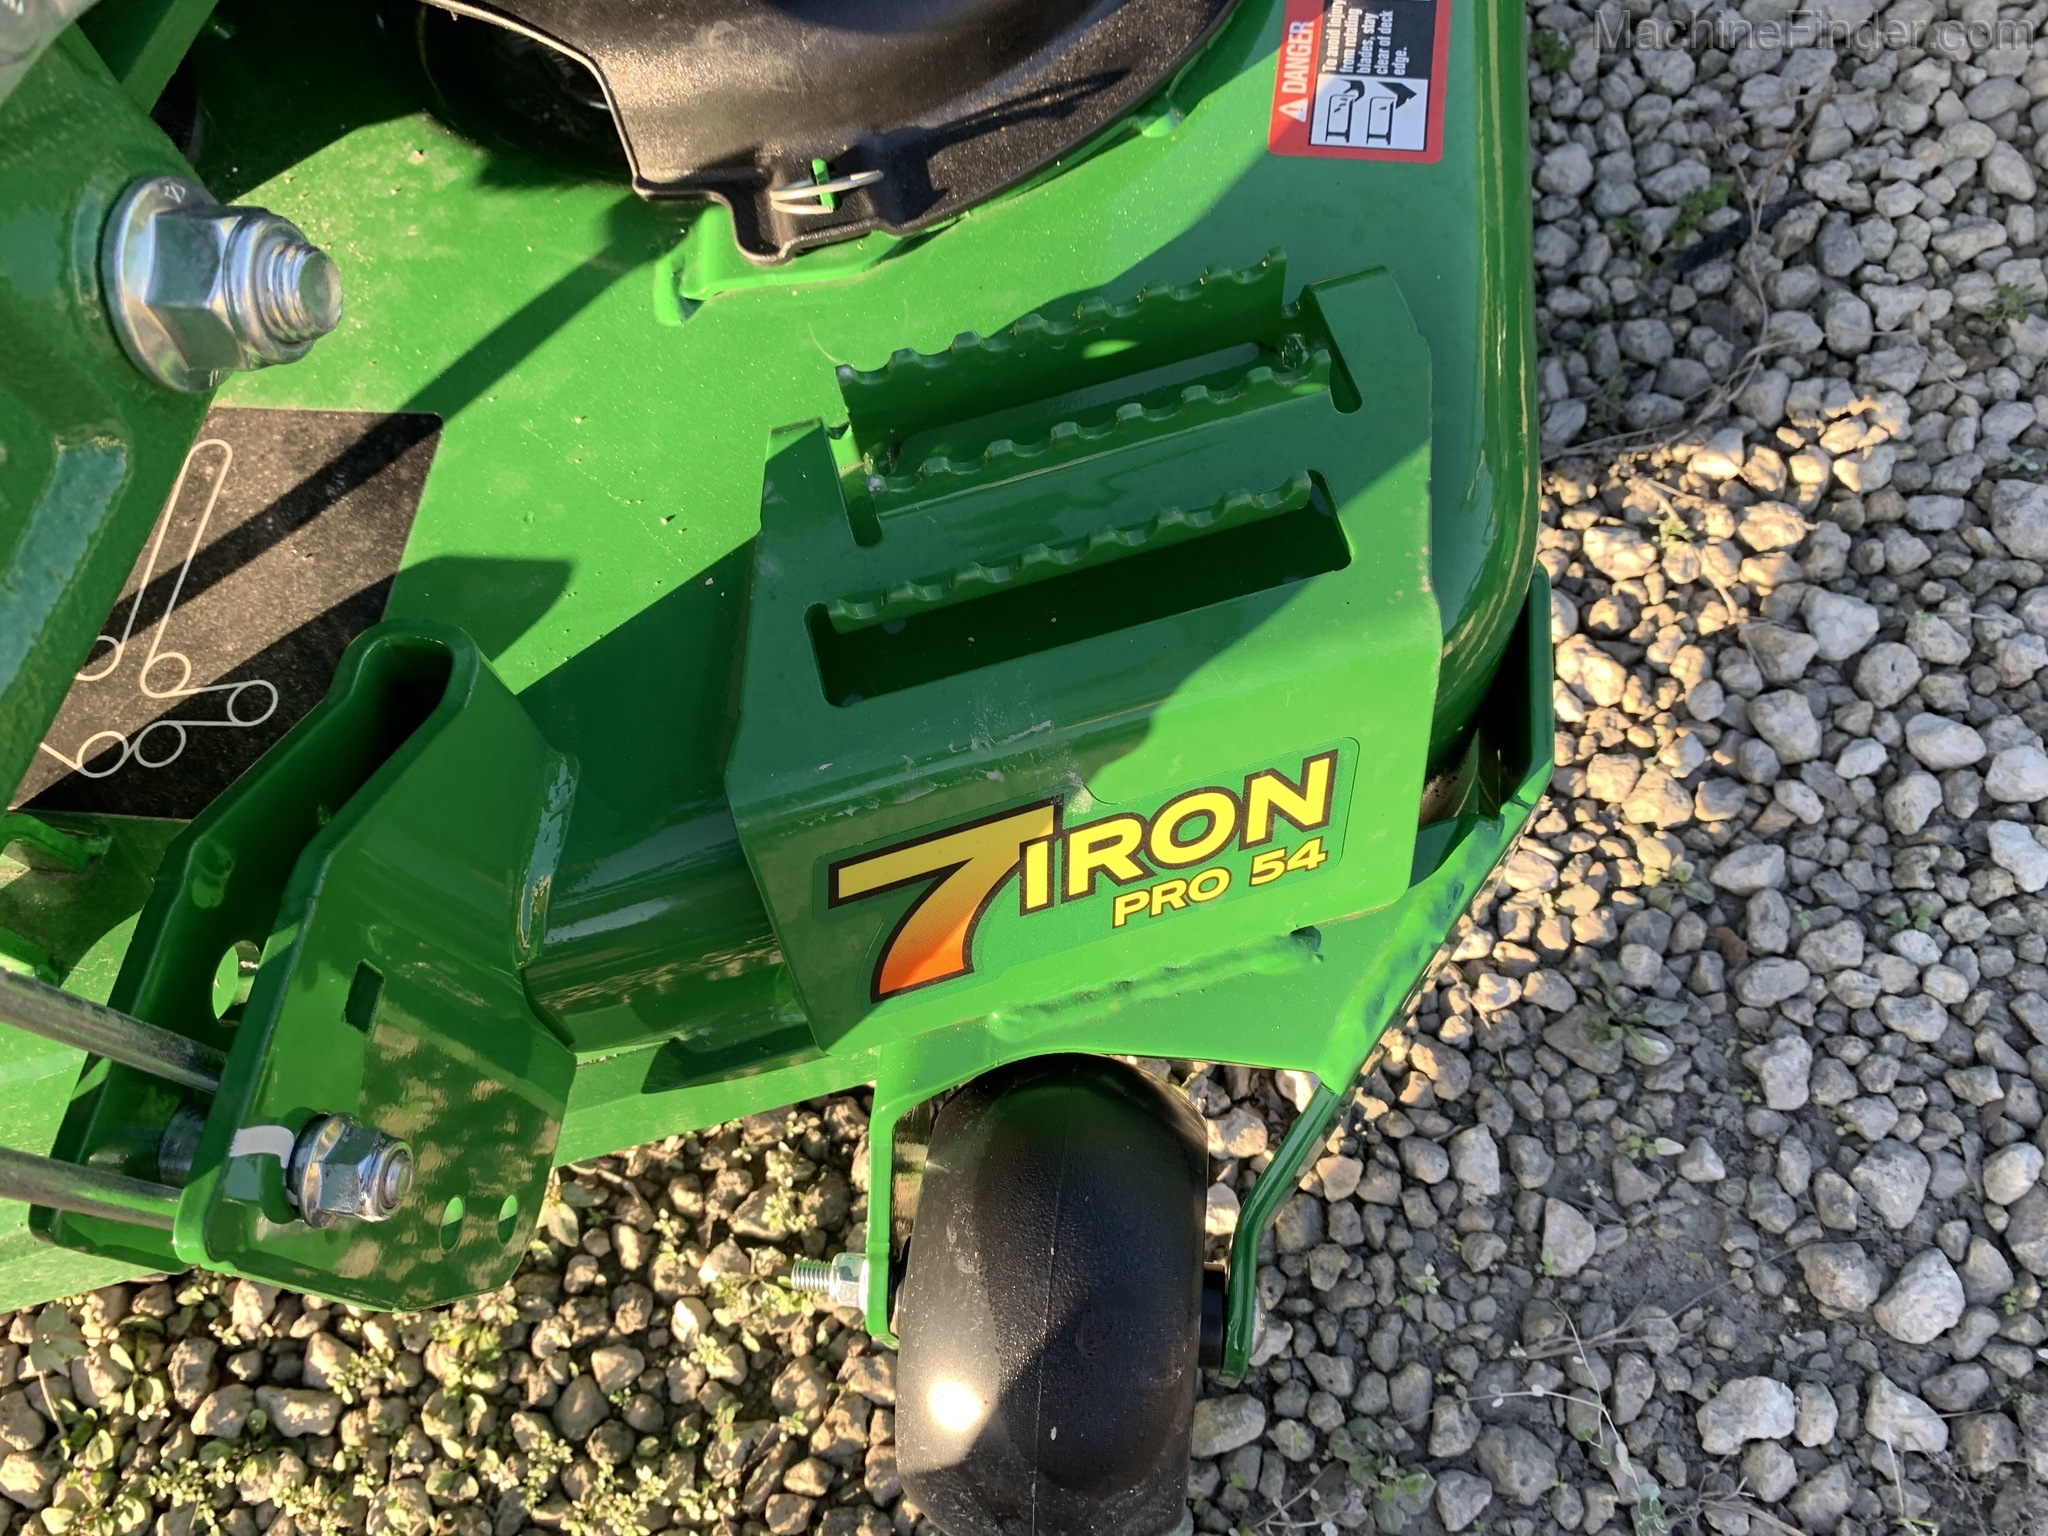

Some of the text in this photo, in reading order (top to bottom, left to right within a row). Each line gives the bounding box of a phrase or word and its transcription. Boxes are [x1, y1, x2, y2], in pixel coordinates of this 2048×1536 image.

[1282, 21, 1315, 94] DANGER
[1322, 0, 1347, 72] To avoid injury
[1339, 8, 1363, 73] from rotating
[1356, 12, 1379, 74] blades, stay
[1374, 10, 1394, 75] clear of deck
[1391, 46, 1410, 76] edge.
[1112, 836, 1329, 930] PRO 54
